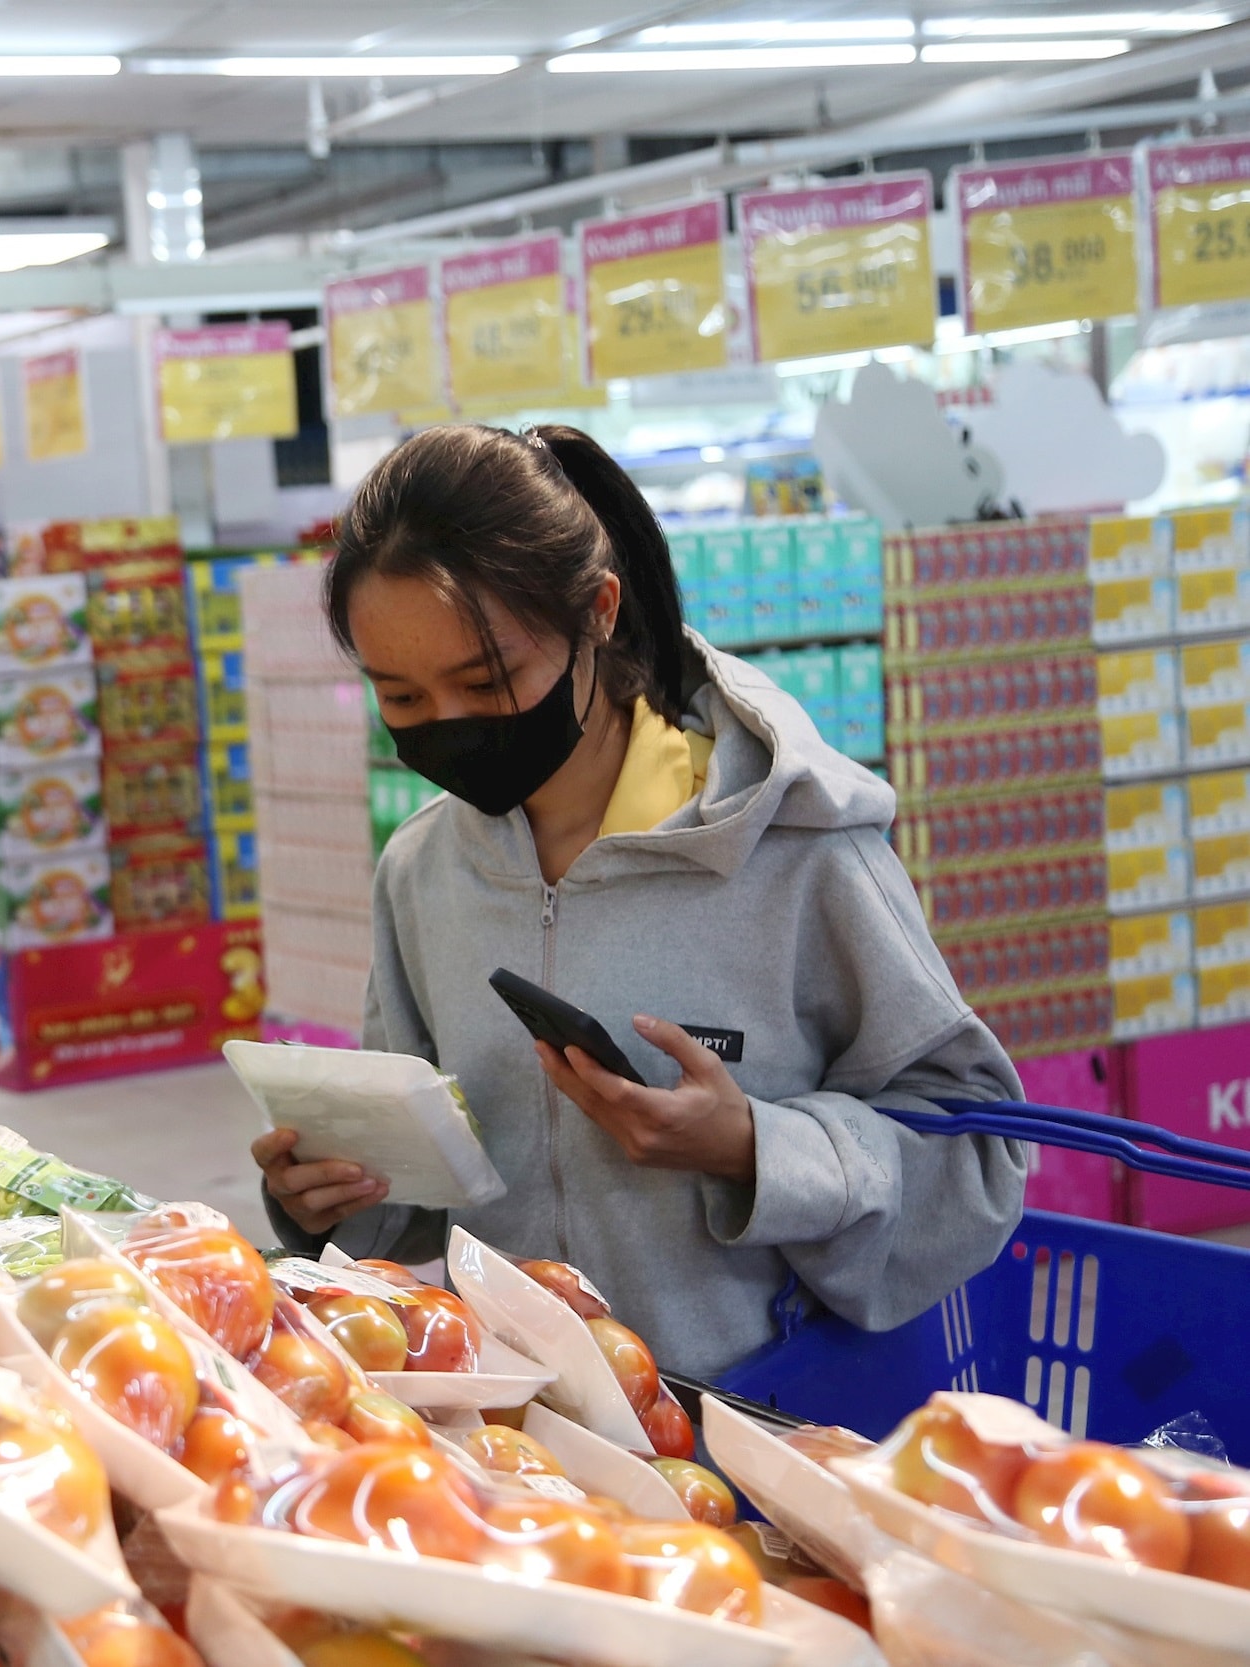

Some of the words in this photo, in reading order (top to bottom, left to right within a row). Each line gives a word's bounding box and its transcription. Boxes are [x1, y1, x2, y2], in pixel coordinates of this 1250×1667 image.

[1194, 217, 1250, 262] 25.
[691, 1035, 729, 1051] MPTI
[1208, 1078, 1250, 1133] K
